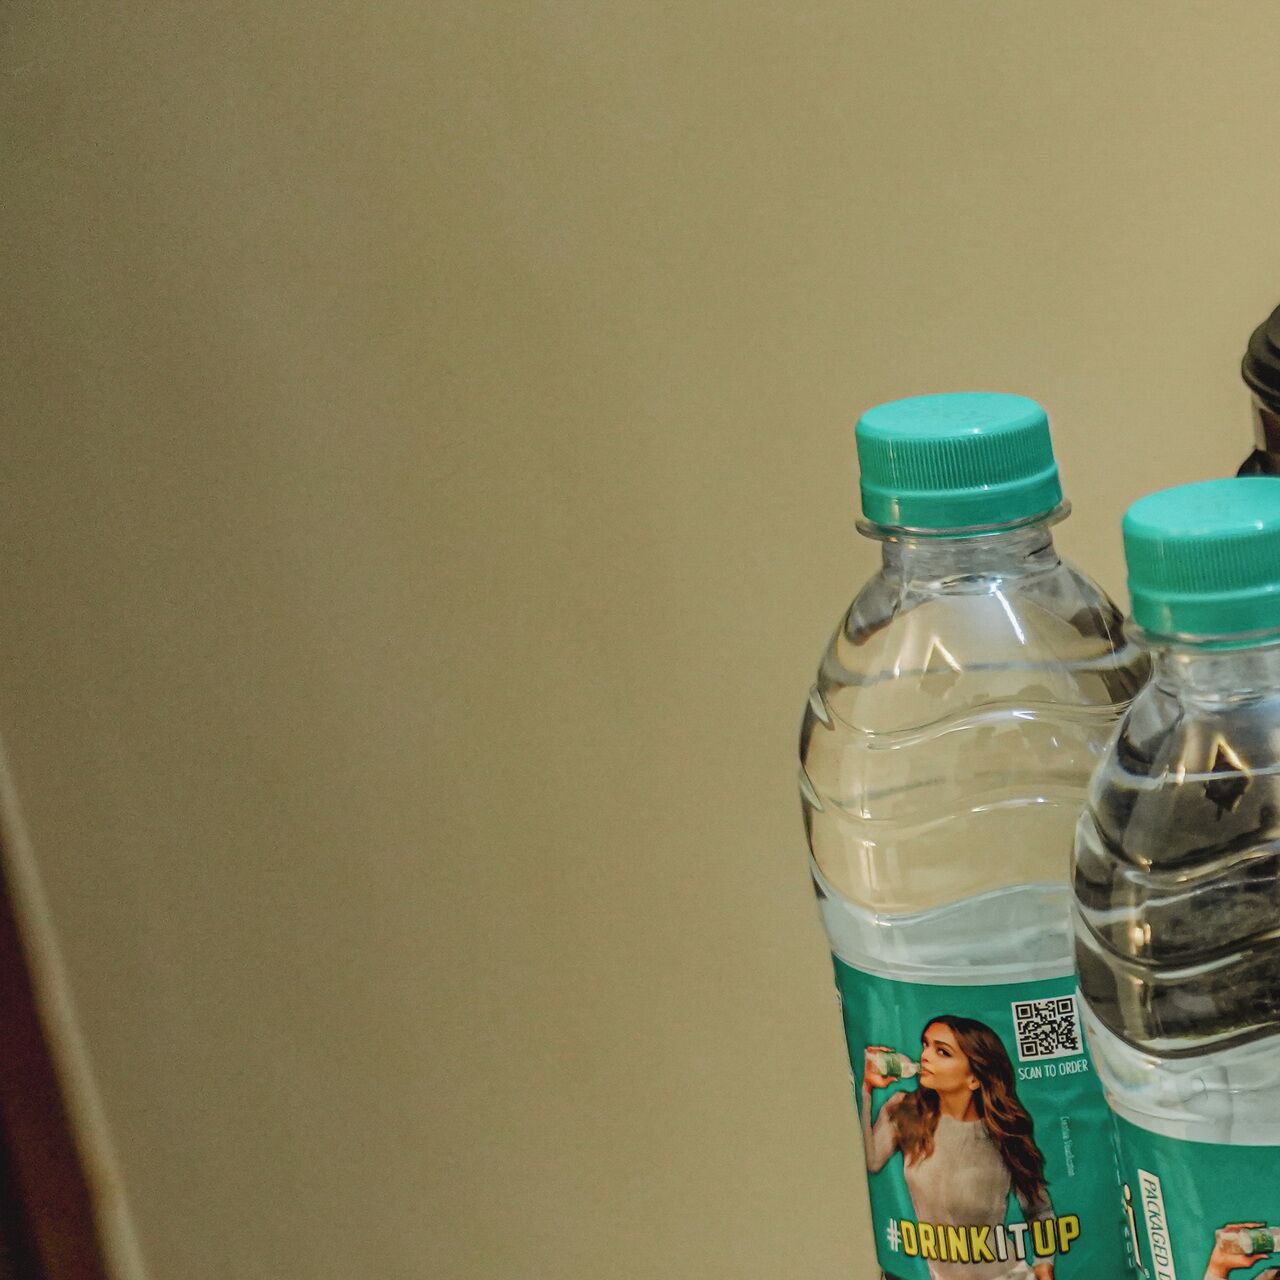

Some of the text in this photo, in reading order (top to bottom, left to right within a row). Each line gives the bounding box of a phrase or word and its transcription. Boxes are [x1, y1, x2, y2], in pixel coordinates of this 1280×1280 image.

[1018, 1058, 1089, 1080] SCAN TO ORDER
[886, 1215, 1081, 1265] #DRINKITUP
[1143, 1177, 1169, 1268] PACKAGED
